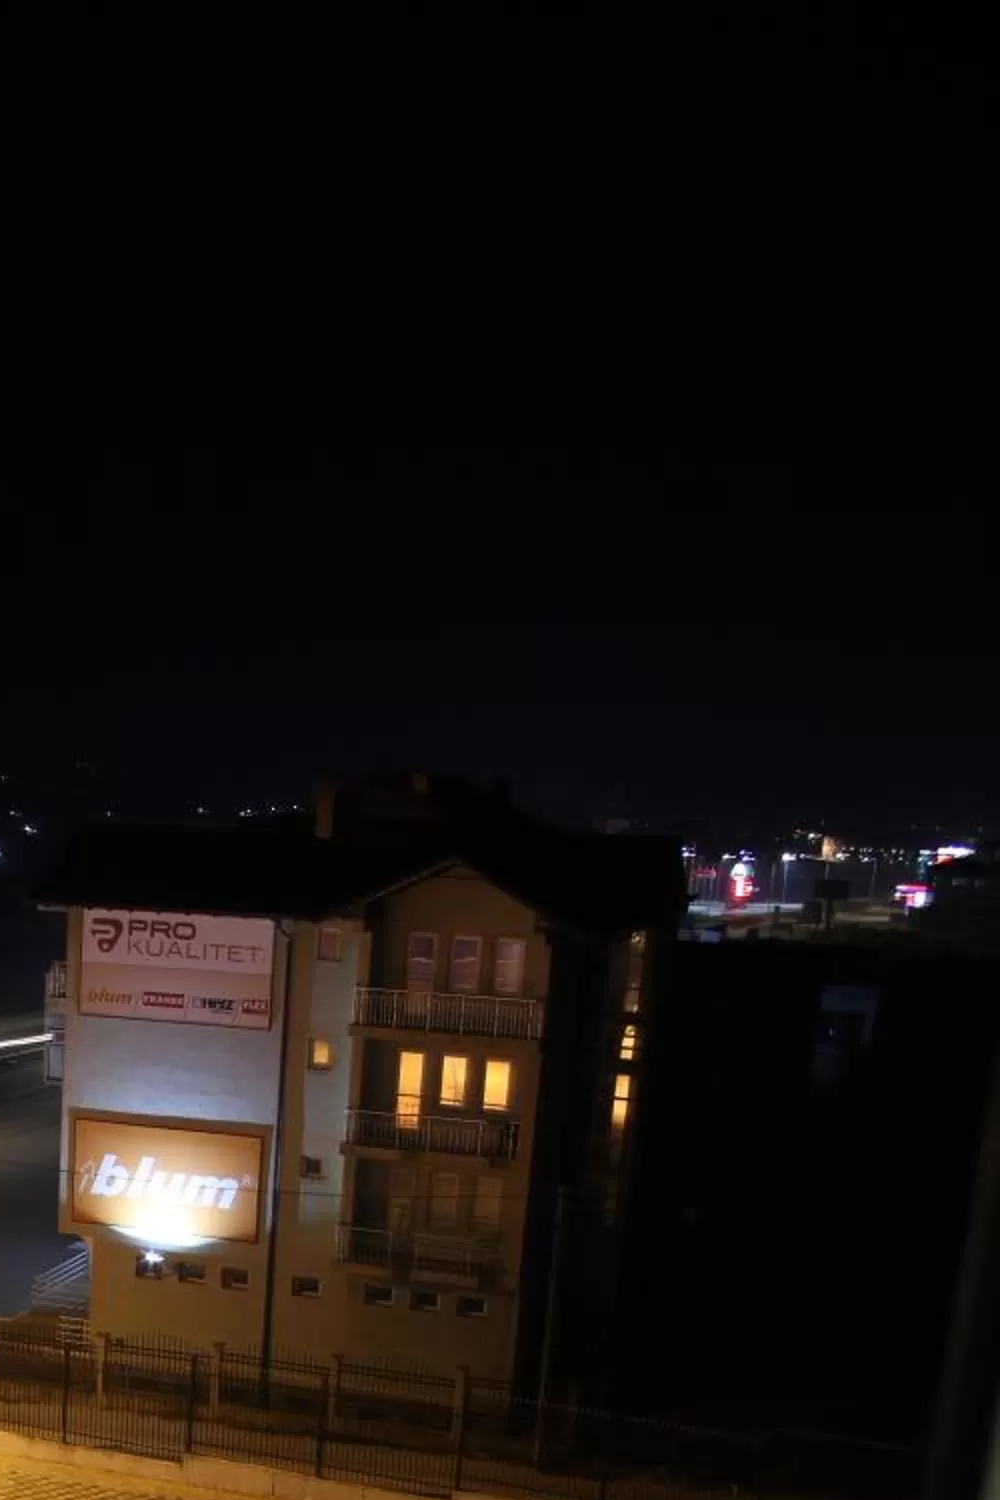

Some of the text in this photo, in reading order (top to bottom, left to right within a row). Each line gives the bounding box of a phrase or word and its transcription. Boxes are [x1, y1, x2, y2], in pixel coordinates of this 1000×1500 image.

[128, 919, 197, 940] PRO
[127, 937, 264, 963] KUALITET
[91, 1152, 240, 1209] blum
